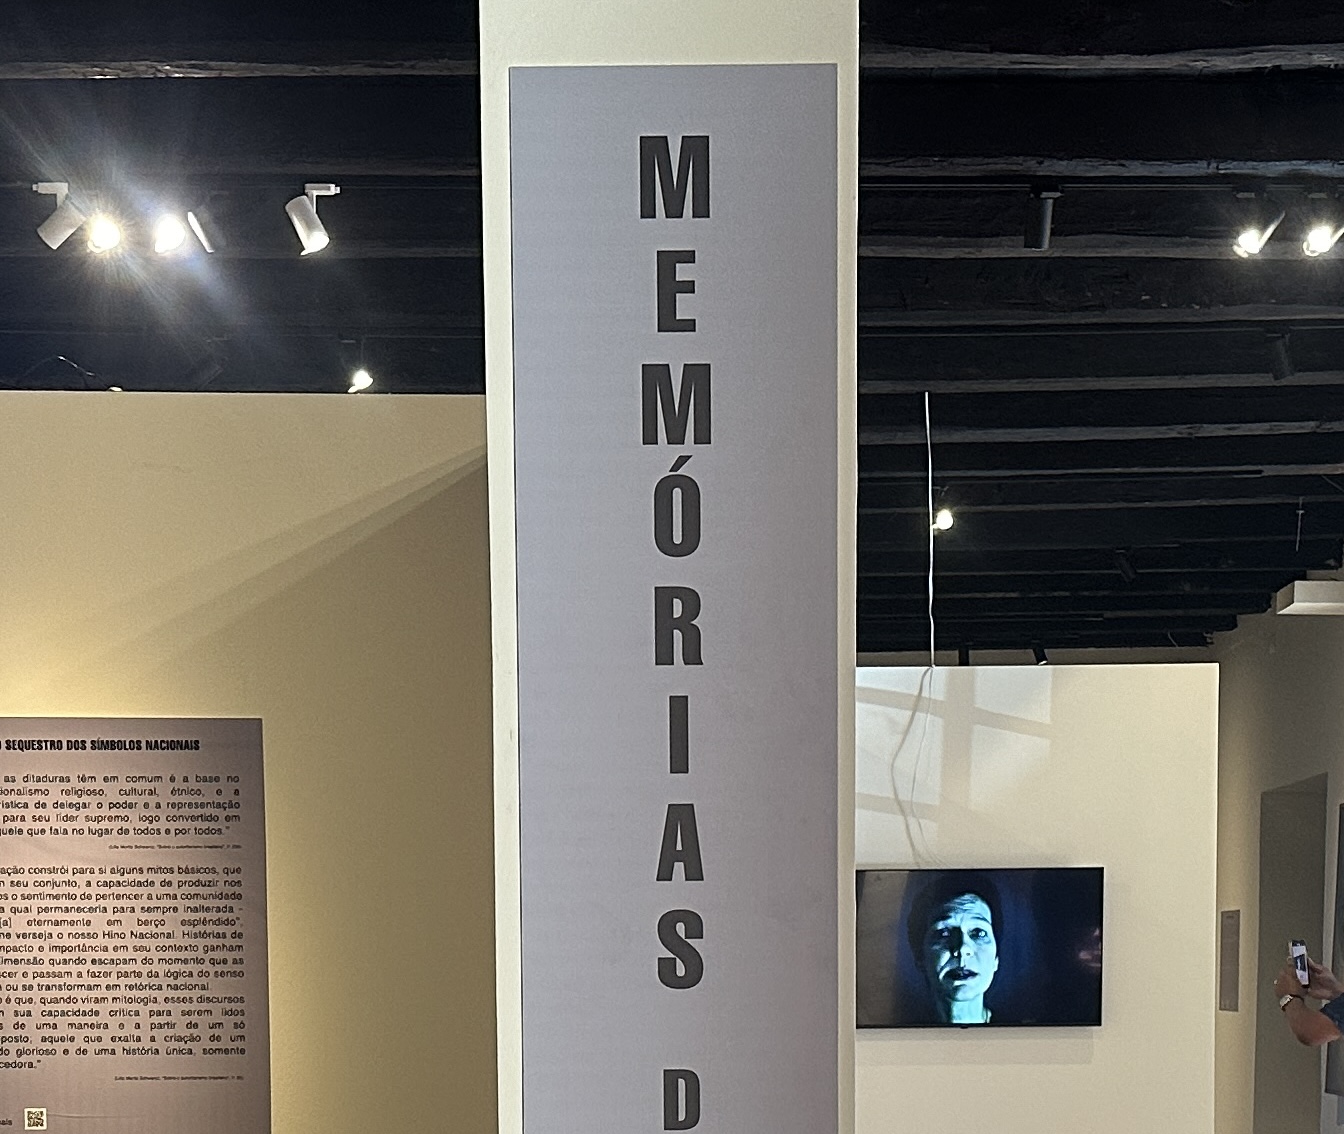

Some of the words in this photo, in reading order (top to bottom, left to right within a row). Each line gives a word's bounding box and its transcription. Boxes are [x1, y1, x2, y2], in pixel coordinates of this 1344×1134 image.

[638, 135, 713, 990] MEMÓRIAS
[4, 740, 64, 752] SEQUESTRO
[65, 740, 88, 750] DOS
[89, 737, 143, 750] SÍMBOLOS
[145, 740, 201, 750] NACIONAIS
[22, 773, 71, 783] ditaduras
[76, 773, 97, 783] têm
[169, 773, 176, 783] é
[195, 773, 221, 783] base
[33, 800, 48, 809] de
[52, 800, 92, 812] delegar
[108, 800, 139, 812] poder
[166, 800, 241, 812] representação
[2, 815, 27, 825] para
[55, 813, 80, 822] líder
[138, 813, 161, 825] logo
[165, 813, 220, 822] convertido
[26, 828, 47, 838] que
[49, 826, 69, 835] fala
[87, 826, 114, 838] lugar
[116, 826, 130, 835] de
[132, 826, 162, 835] todos
[174, 828, 191, 838] por
[27, 865, 69, 874] constrói
[71, 867, 96, 877] para
[97, 865, 107, 874] si
[109, 865, 145, 877] alguns
[146, 865, 175, 874] mitos
[222, 867, 242, 877] que
[95, 878, 156, 890] capacidade
[159, 878, 173, 887] de
[177, 878, 220, 890] produzir
[19, 891, 78, 900] sentimento
[79, 891, 93, 900] de
[94, 891, 145, 903] pertencer
[179, 891, 243, 900] comunidade
[9, 904, 33, 916] qual
[36, 904, 108, 916] permaneceria
[112, 907, 136, 916] para
[140, 907, 179, 916] sempre
[183, 904, 235, 913] inalterada
[26, 917, 92, 926] eternamente
[136, 917, 166, 929] berço
